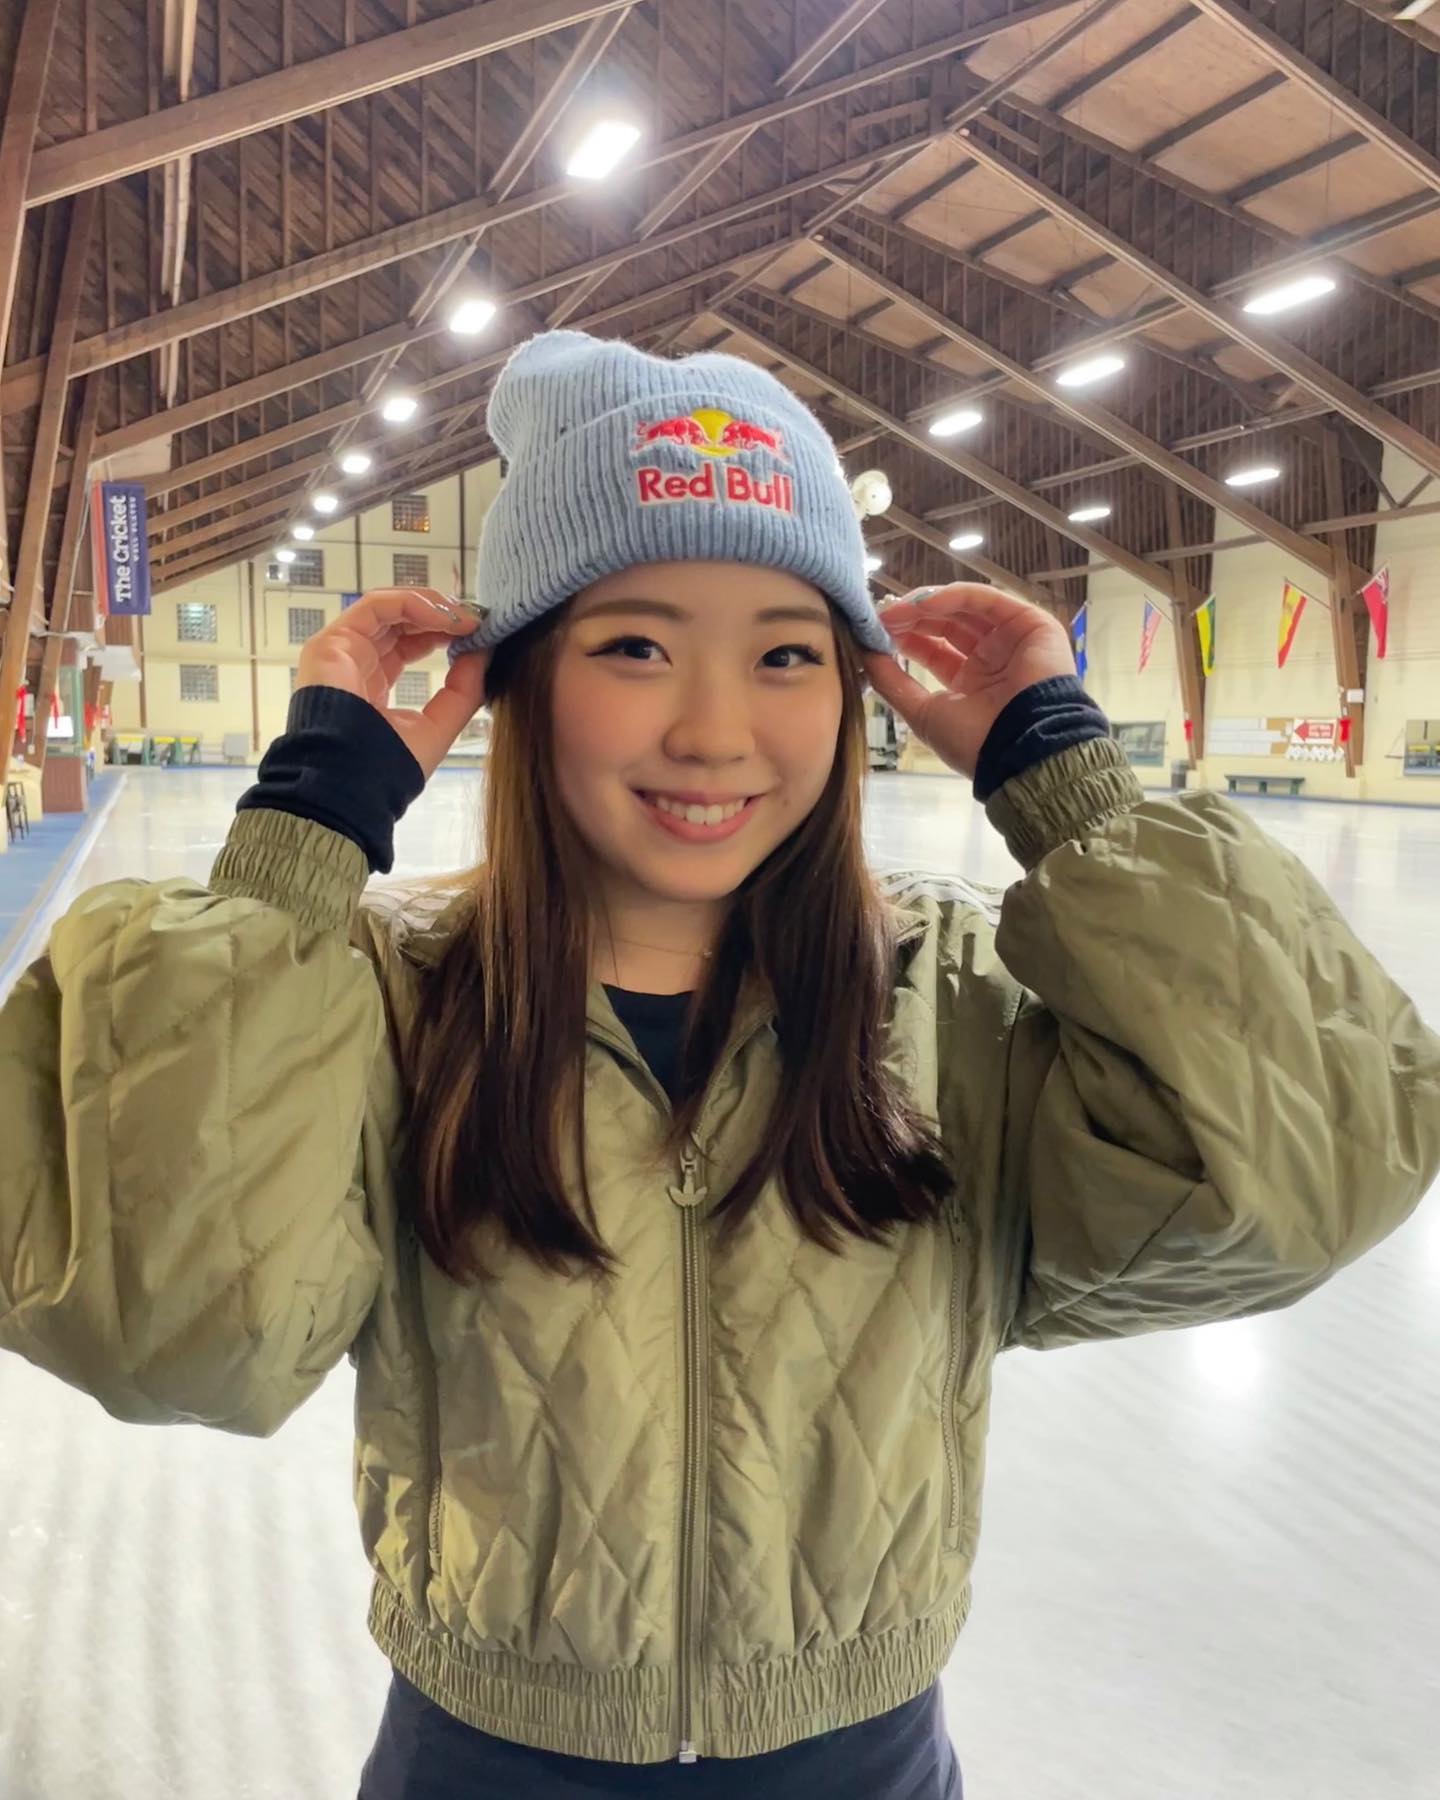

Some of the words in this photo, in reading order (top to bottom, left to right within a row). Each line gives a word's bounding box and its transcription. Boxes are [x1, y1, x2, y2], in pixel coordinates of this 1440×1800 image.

[637, 462, 715, 503] Red
[726, 465, 793, 514] Bull
[110, 494, 130, 563] Cricket
[115, 565, 132, 603] The
